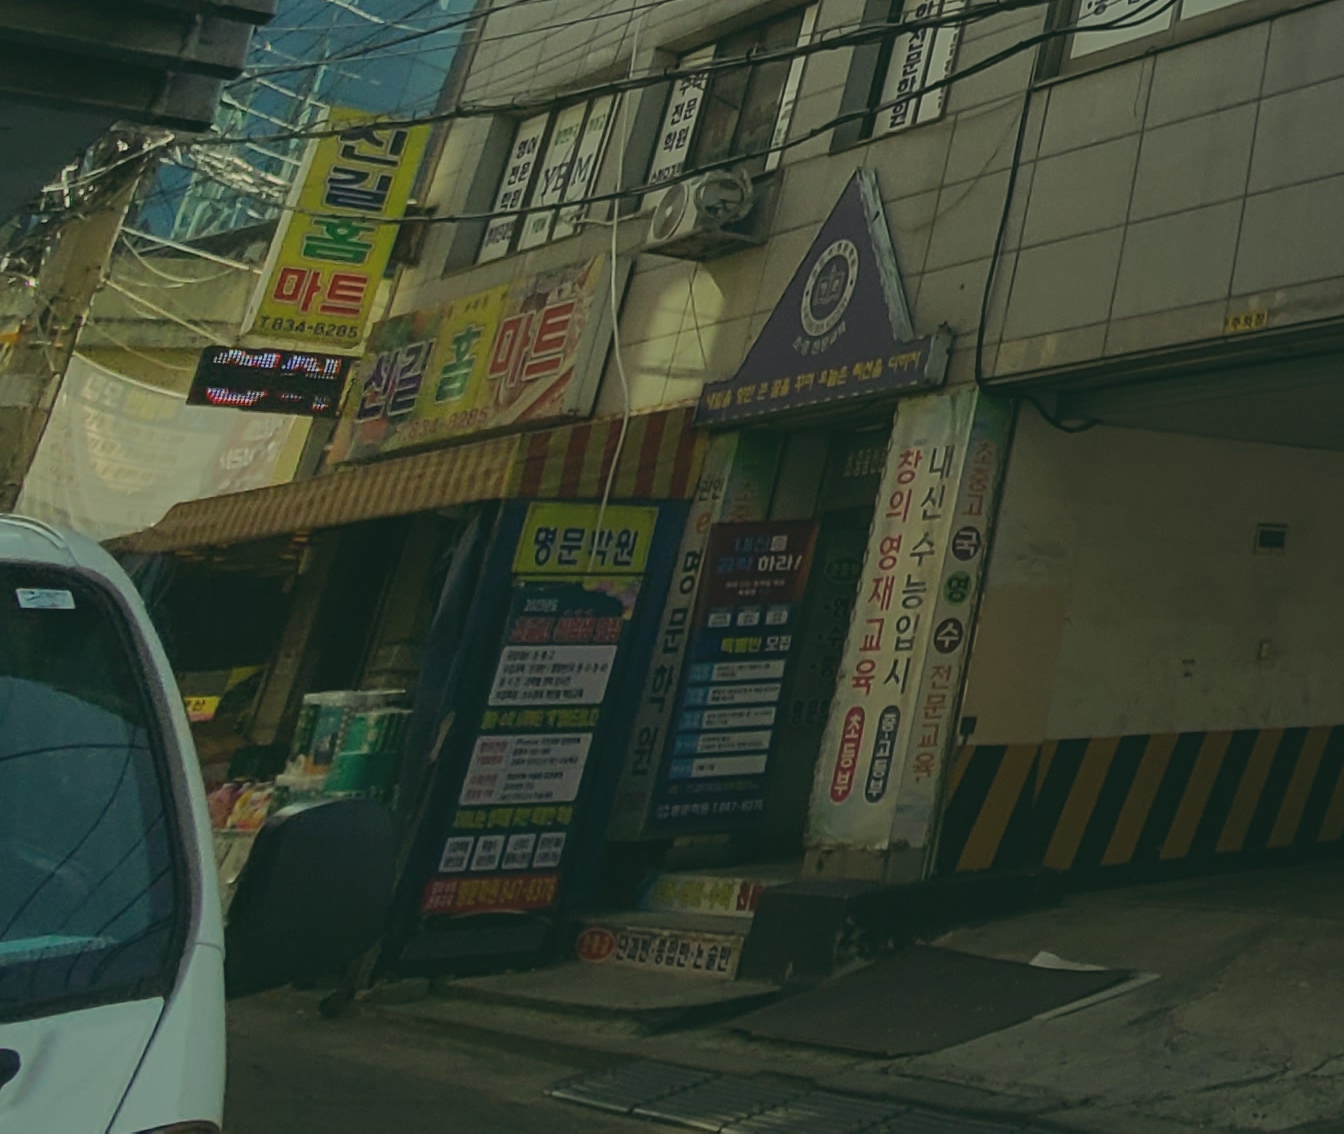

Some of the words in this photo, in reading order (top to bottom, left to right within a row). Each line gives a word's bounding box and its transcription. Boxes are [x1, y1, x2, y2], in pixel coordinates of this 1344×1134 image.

[663, 125, 690, 152] 학원
[671, 97, 697, 126] 전문
[272, 266, 370, 318] 마트
[435, 322, 484, 405] 홈
[488, 300, 576, 392] 마트
[885, 449, 923, 524] 창의
[920, 443, 954, 521] 내신
[533, 526, 638, 566] 명문학원
[850, 534, 902, 696] 영재교육
[883, 530, 934, 695] 수능입시
[631, 548, 703, 777] 명문학원
[834, 713, 862, 797] 초등부
[913, 665, 953, 782] 전문교육
